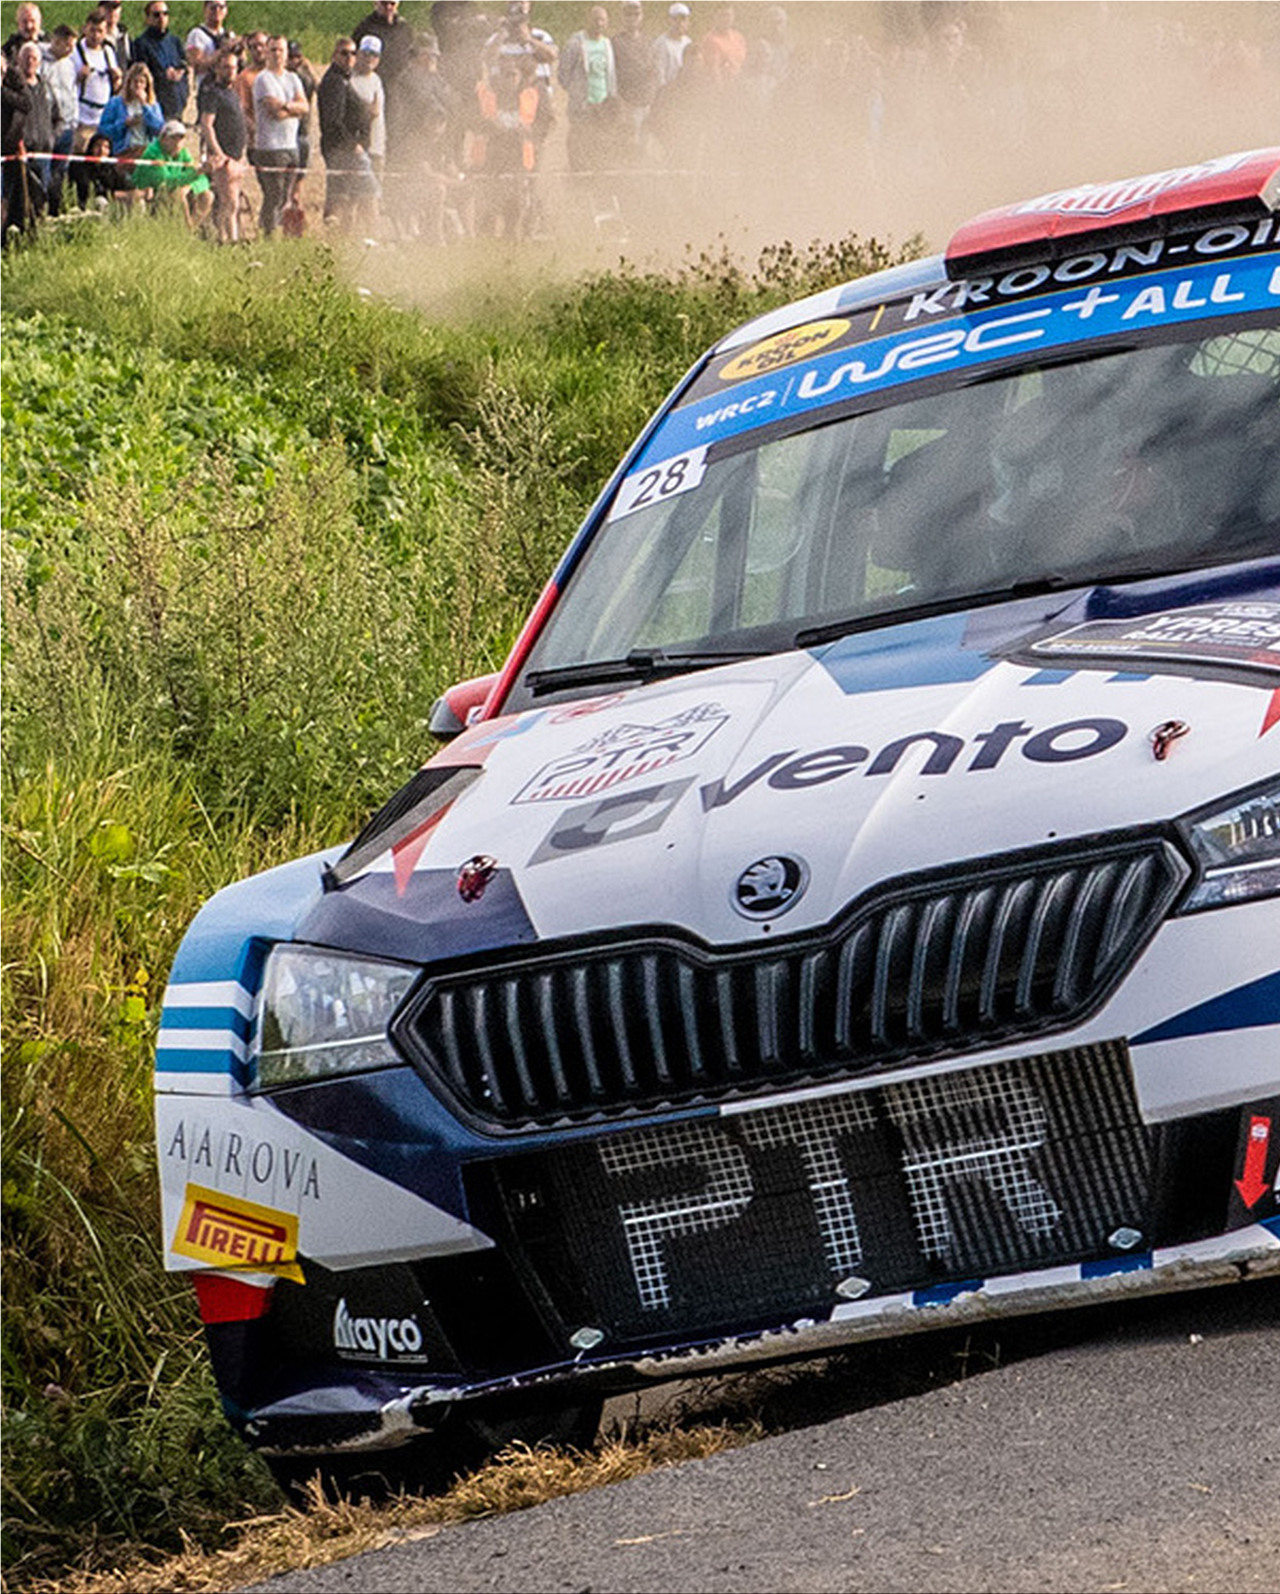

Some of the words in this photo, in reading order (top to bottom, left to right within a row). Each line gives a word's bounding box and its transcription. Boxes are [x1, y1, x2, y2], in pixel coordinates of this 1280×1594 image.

[695, 390, 777, 429] WRC2
[1121, 275, 1245, 319] ALL
[736, 328, 831, 371] KROON
[757, 350, 797, 370] OIL
[629, 457, 690, 510] 28
[1121, 630, 1207, 643] RALLY
[540, 731, 696, 788] PTR
[700, 717, 1128, 813] vento
[167, 1120, 321, 1200] AAROVA
[600, 1068, 1064, 1312] PTR
[185, 1199, 288, 1264] PIRELLI
